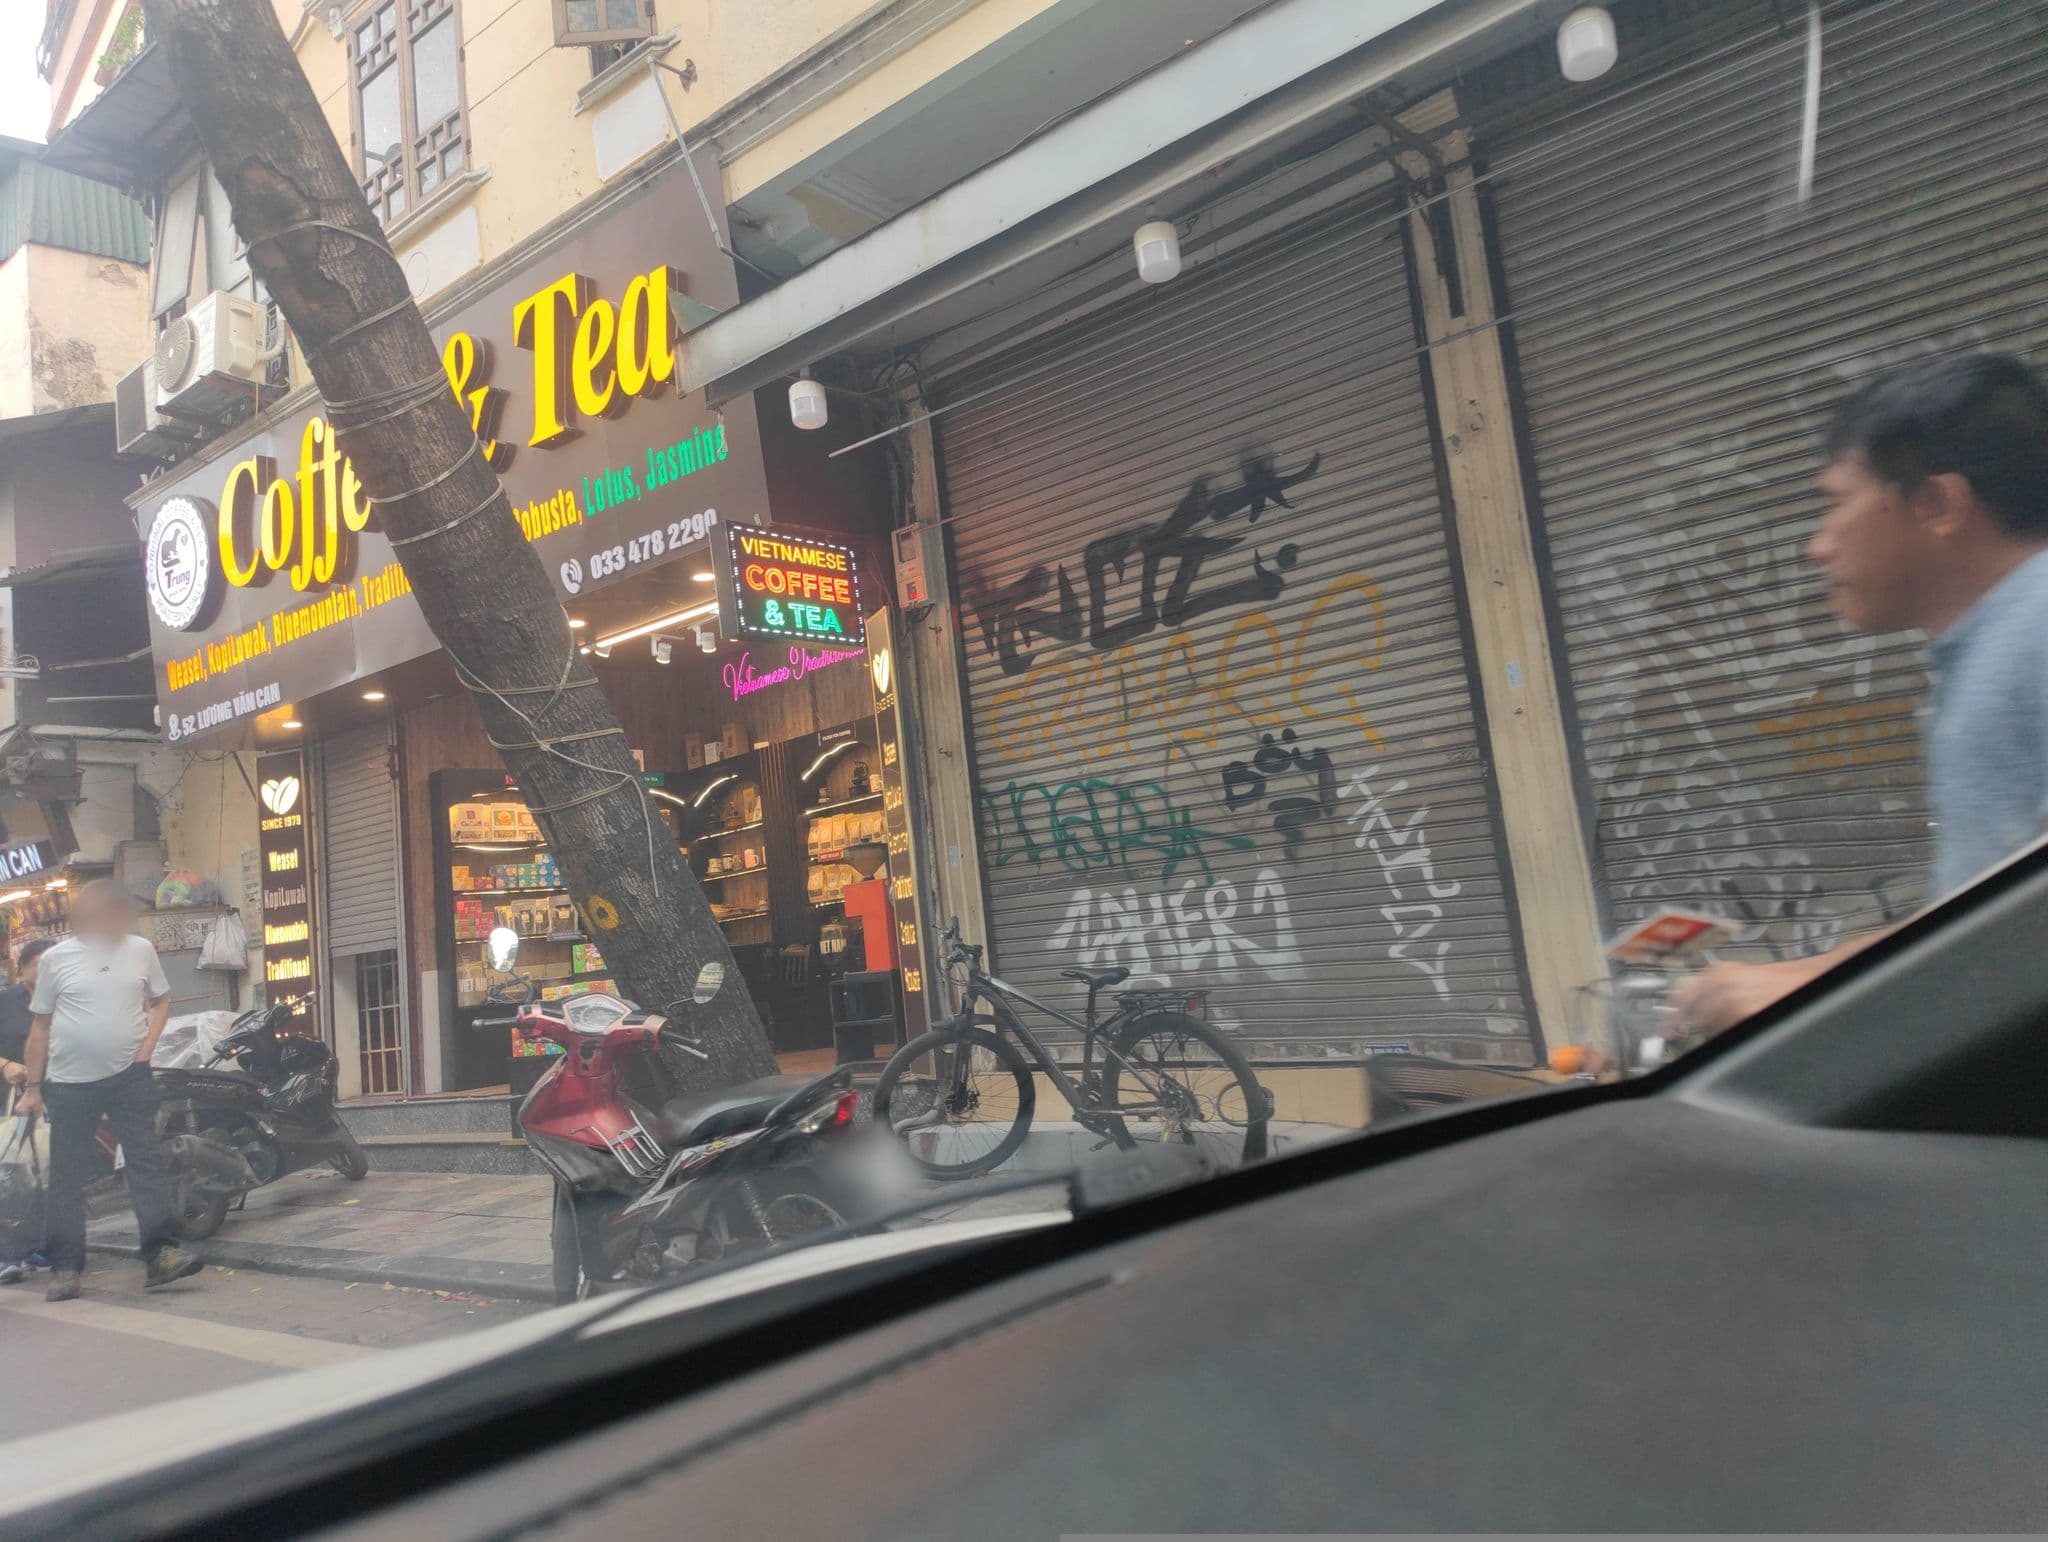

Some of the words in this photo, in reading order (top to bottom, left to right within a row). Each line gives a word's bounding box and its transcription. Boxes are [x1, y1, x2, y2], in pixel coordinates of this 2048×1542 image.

[218, 416, 372, 592] Coffe
[442, 331, 496, 464] &
[512, 264, 675, 448] Tea
[166, 649, 208, 692] Weasel,
[272, 585, 363, 646] Bluemountain,
[583, 465, 641, 517] Lotus,
[646, 424, 728, 491] Jasmine
[590, 545, 626, 580] 033
[628, 529, 665, 564] 478
[740, 536, 848, 572] VIETNAMESE
[165, 569, 190, 589] Trung
[745, 563, 852, 604] COFFEE
[764, 599, 786, 626] &
[787, 602, 843, 633] TEA
[722, 651, 791, 702] Vietnamese
[182, 715, 197, 736] 52
[233, 690, 256, 716] VĂN
[256, 682, 281, 708] CAN
[261, 817, 283, 831] SINCE
[8, 844, 43, 876] CAN
[268, 848, 298, 872] Weasel
[264, 883, 306, 910] KopiLuwak
[266, 955, 310, 981] Traditional
